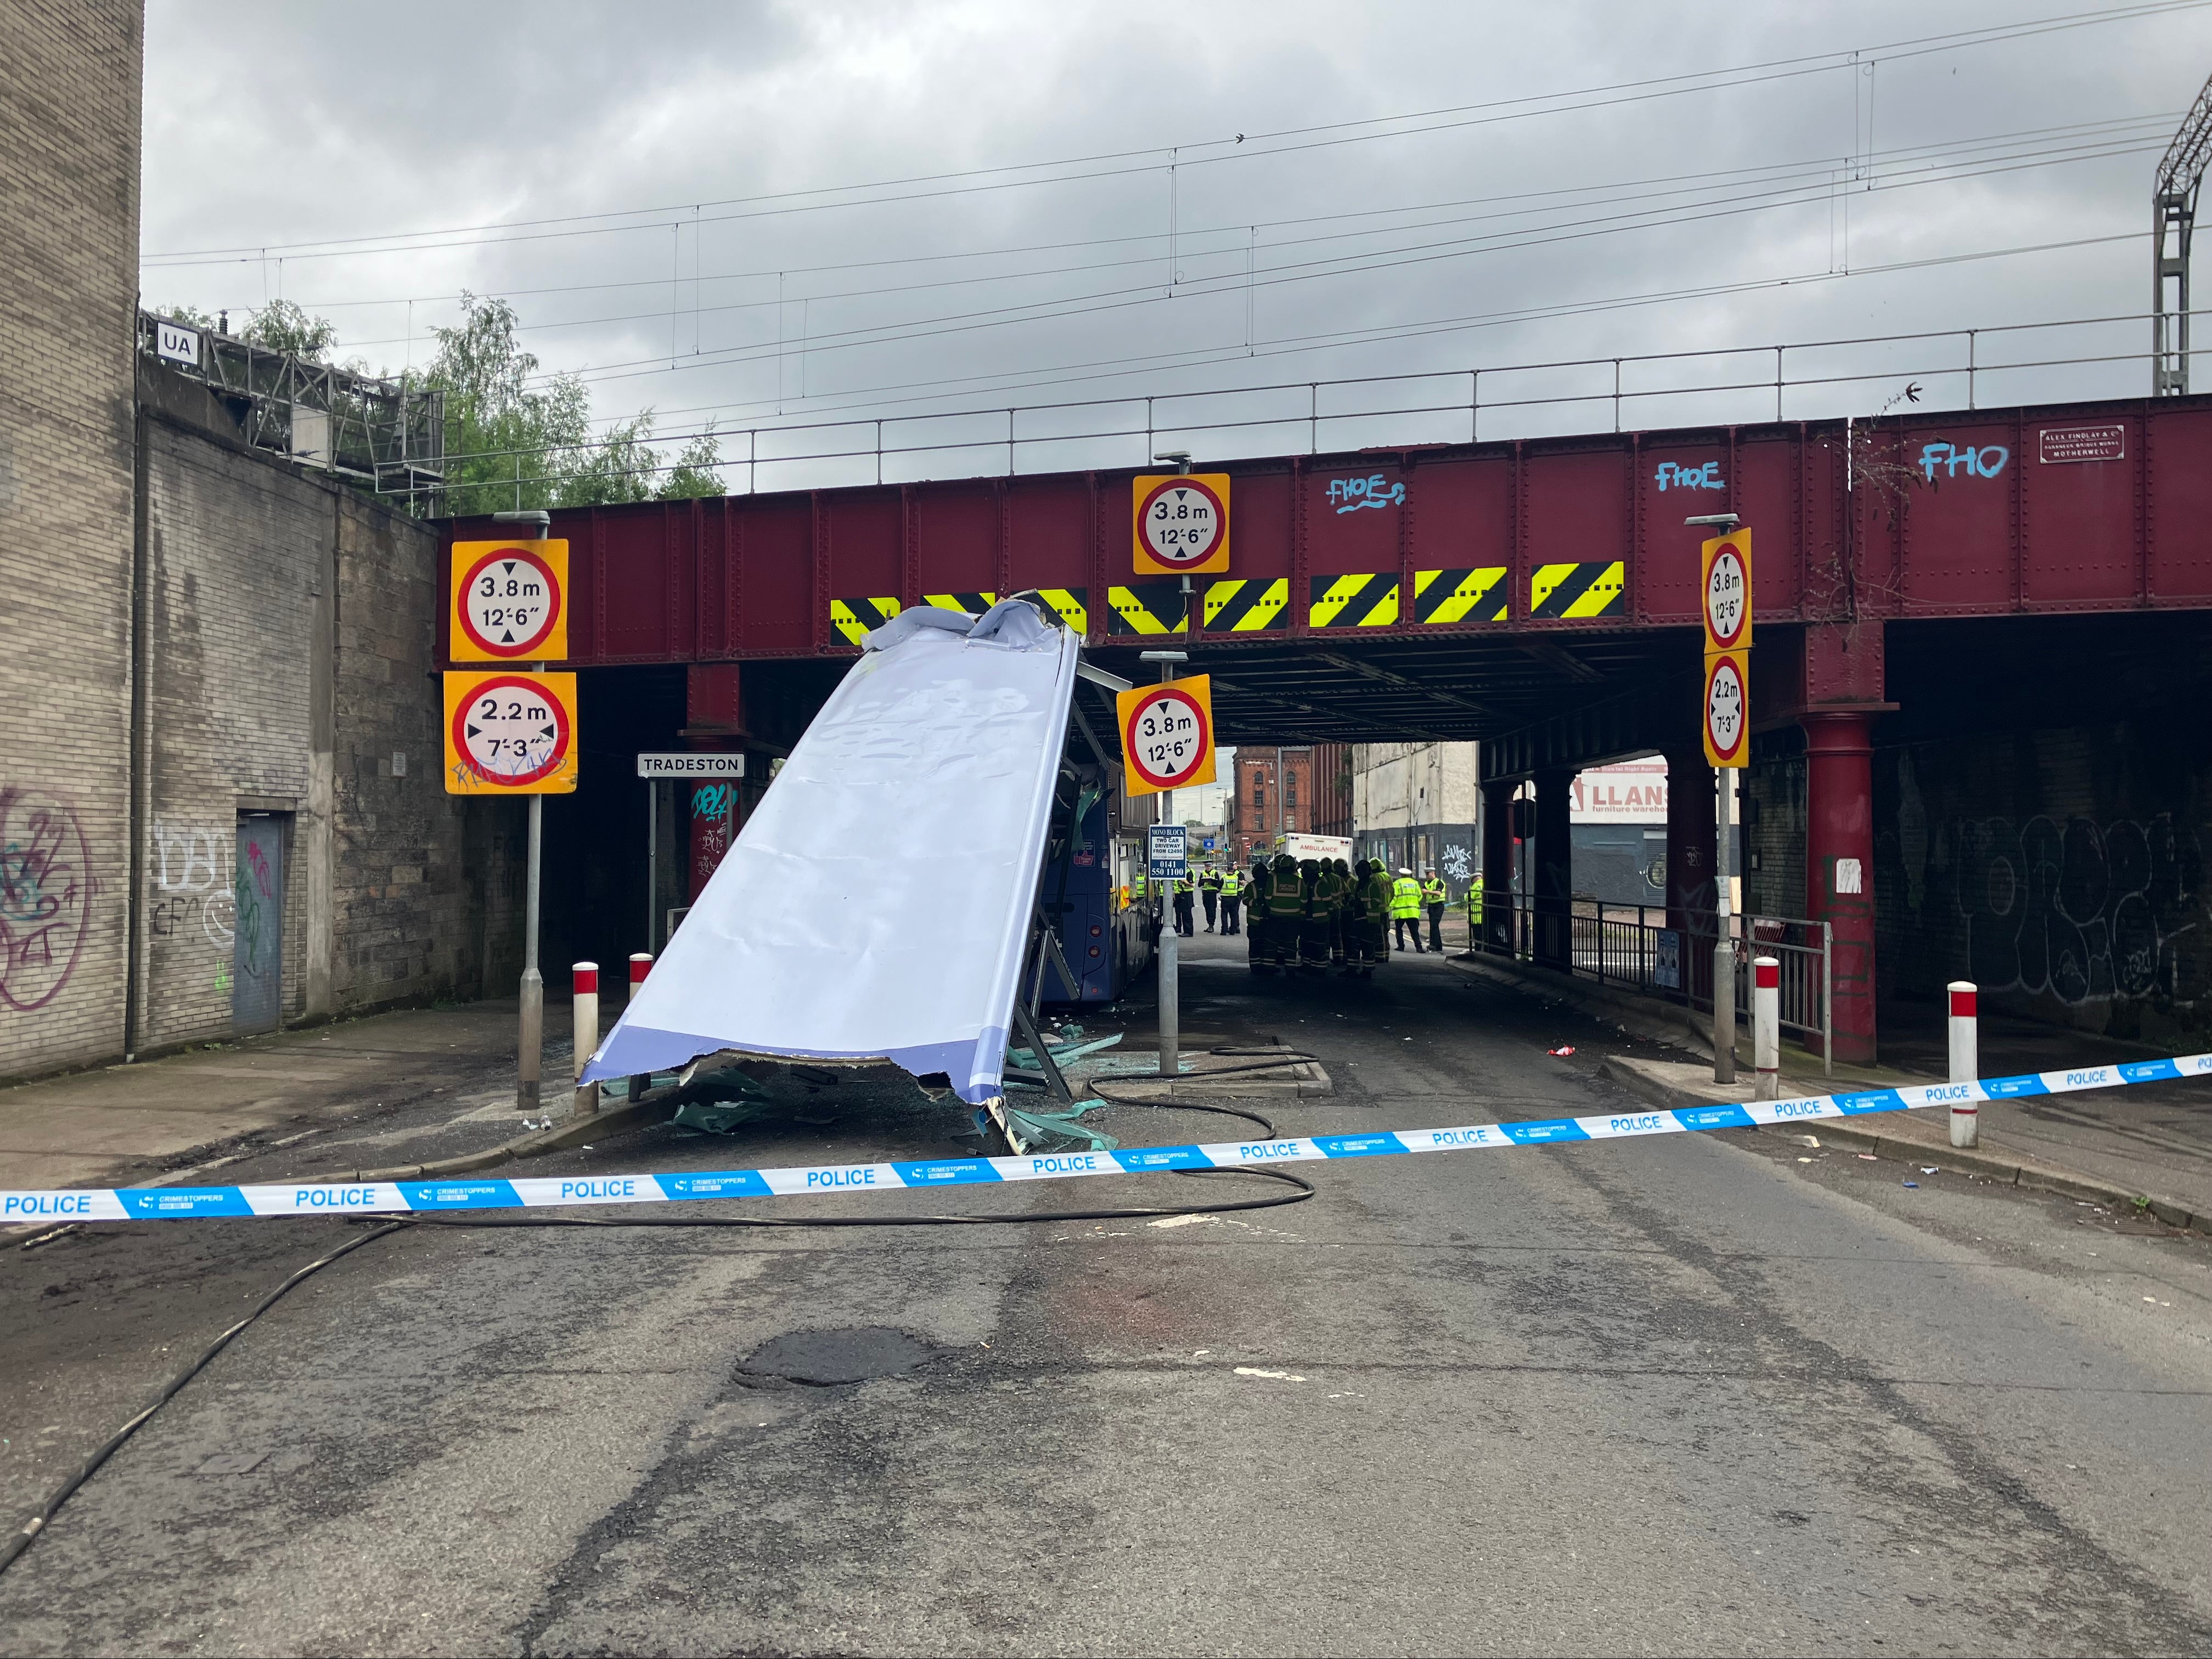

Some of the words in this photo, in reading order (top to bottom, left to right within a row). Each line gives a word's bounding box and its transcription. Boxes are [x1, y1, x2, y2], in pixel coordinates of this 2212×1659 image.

[164, 332, 191, 356] UA
[2053, 448, 2109, 457] MOTHERWELL
[1919, 443, 2009, 482] FHO
[644, 759, 738, 770] TRADESTON
[2067, 1070, 2107, 1085] POLICE
[1926, 1085, 1969, 1101] POLICE
[1775, 1101, 1822, 1117] POLICE
[1611, 1115, 1662, 1132] POLICE
[1432, 1130, 1489, 1146] POLICE
[1240, 1143, 1300, 1159] POLICE
[1033, 1156, 1096, 1173] POLICE
[692, 1177, 746, 1186] CRIMESTOPPERS
[807, 1169, 875, 1187] POLICE
[296, 1189, 375, 1206] POLICE
[562, 1181, 635, 1198] POLICE
[5, 1195, 91, 1214] POLICE
